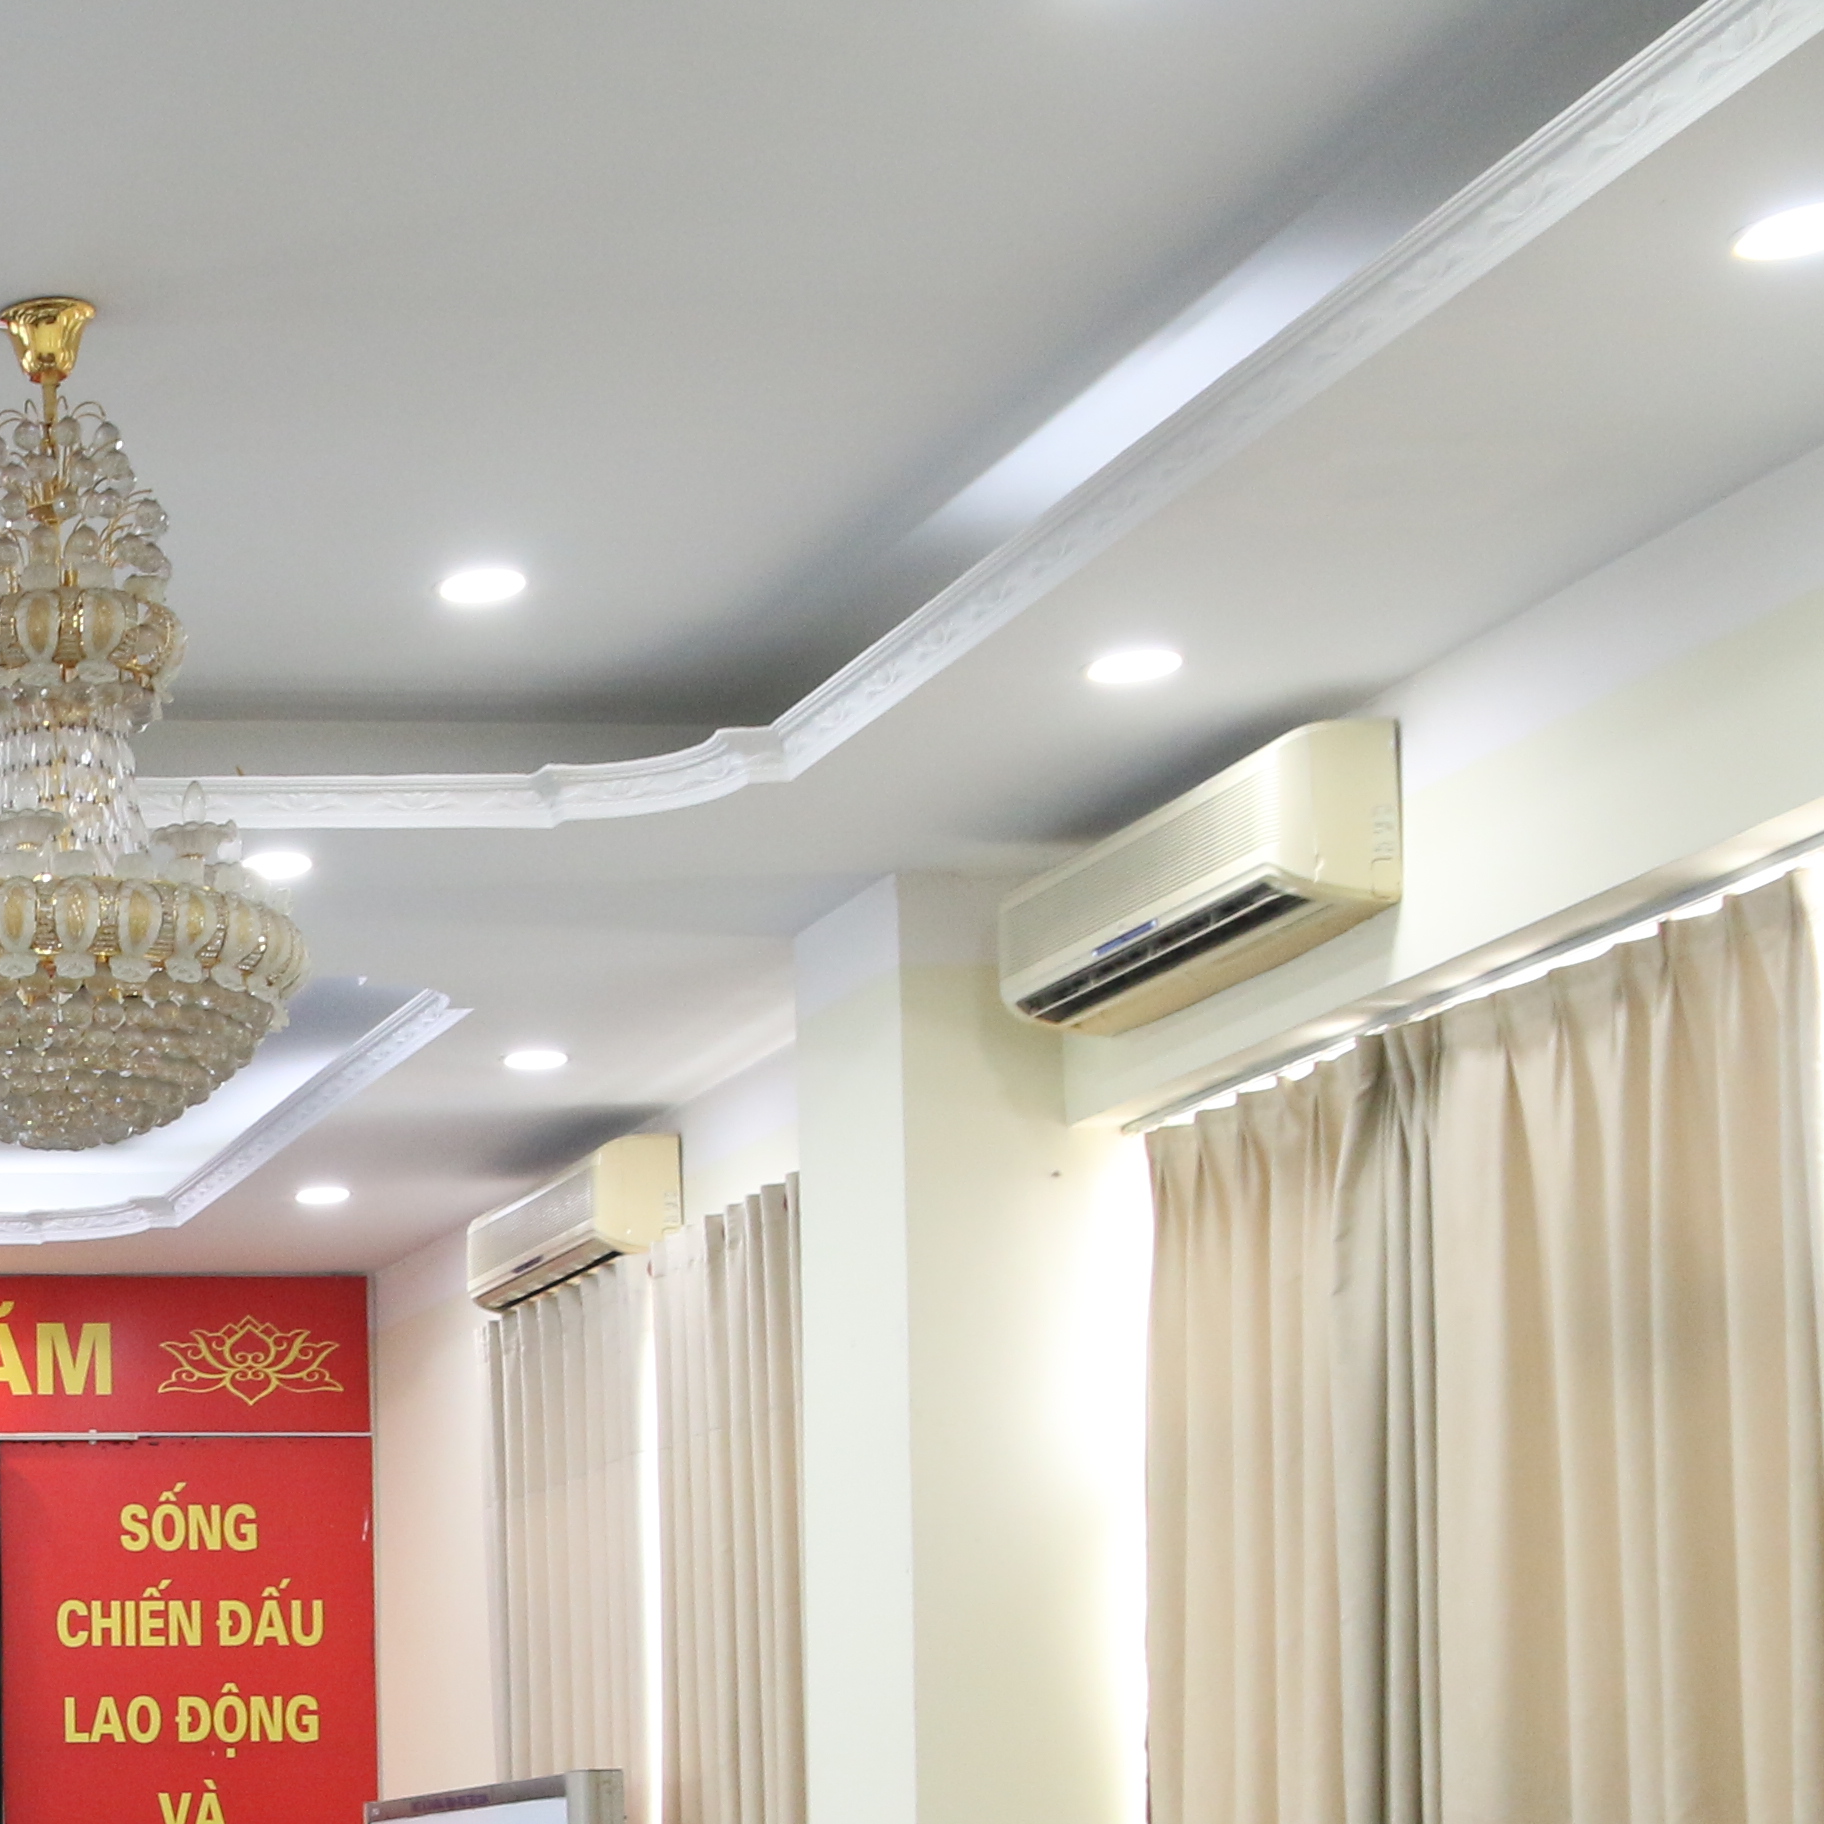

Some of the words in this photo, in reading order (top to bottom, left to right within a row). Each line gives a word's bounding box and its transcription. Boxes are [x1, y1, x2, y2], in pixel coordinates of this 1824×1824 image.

[121, 1483, 257, 1551] SỐNG
[57, 1580, 201, 1647] CHIẾN
[216, 1579, 323, 1646] ĐẤU
[65, 1696, 161, 1743] LAO
[176, 1683, 319, 1757] ĐỘNG
